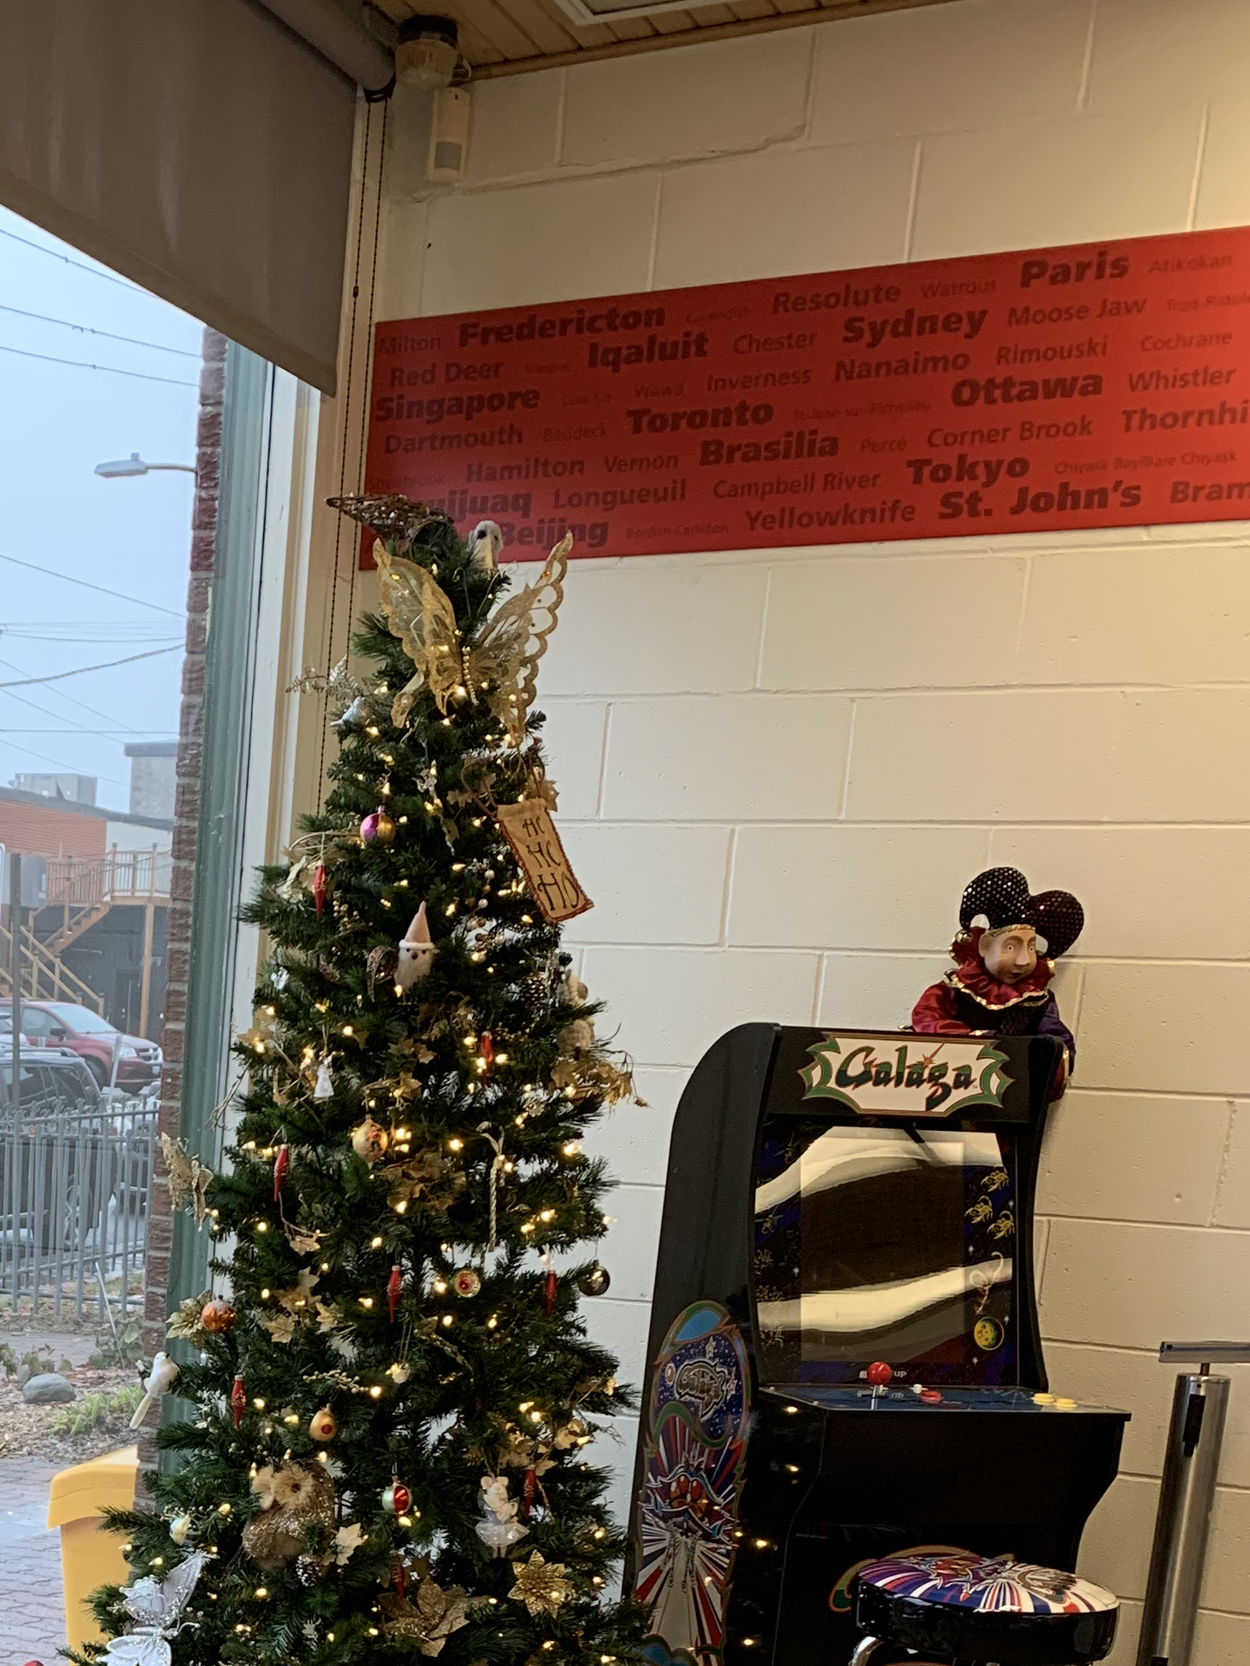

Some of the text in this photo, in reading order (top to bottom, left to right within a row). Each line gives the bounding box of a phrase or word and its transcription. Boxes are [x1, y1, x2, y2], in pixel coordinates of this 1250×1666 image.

[1021, 252, 1130, 288] Paris
[773, 281, 901, 314] Resolute
[1009, 302, 1089, 326] Moose
[1096, 298, 1148, 319] Jaw
[459, 305, 665, 347] Fredericton
[843, 308, 988, 348] Sydney
[380, 334, 441, 354] Milton
[588, 332, 708, 373] Iqaluit
[734, 331, 818, 354] Chester
[997, 337, 1108, 365] Rimouski
[1141, 331, 1232, 352] Cochrane
[391, 366, 436, 386] Red
[445, 360, 503, 383] Deer
[708, 367, 812, 391] Inverness
[835, 352, 970, 381] Nanaimo
[1129, 367, 1236, 392] Whistler
[375, 388, 540, 423] Singapore
[952, 374, 1103, 407] Ottawa
[627, 401, 774, 435] Toronto
[928, 416, 1093, 448] Corner Brook
[385, 423, 523, 453] Dartmouth
[700, 430, 839, 465] Brasilia
[467, 456, 585, 482] Hamilton
[605, 454, 678, 472] Vernon
[906, 454, 1030, 488] Tokyo
[554, 479, 686, 511] Longueuil
[713, 471, 880, 500] Campbell River
[938, 481, 1141, 519] St. John's
[745, 501, 916, 531] Yellowknife
[500, 518, 609, 547] Beijing
[835, 1043, 977, 1112] Galaga
